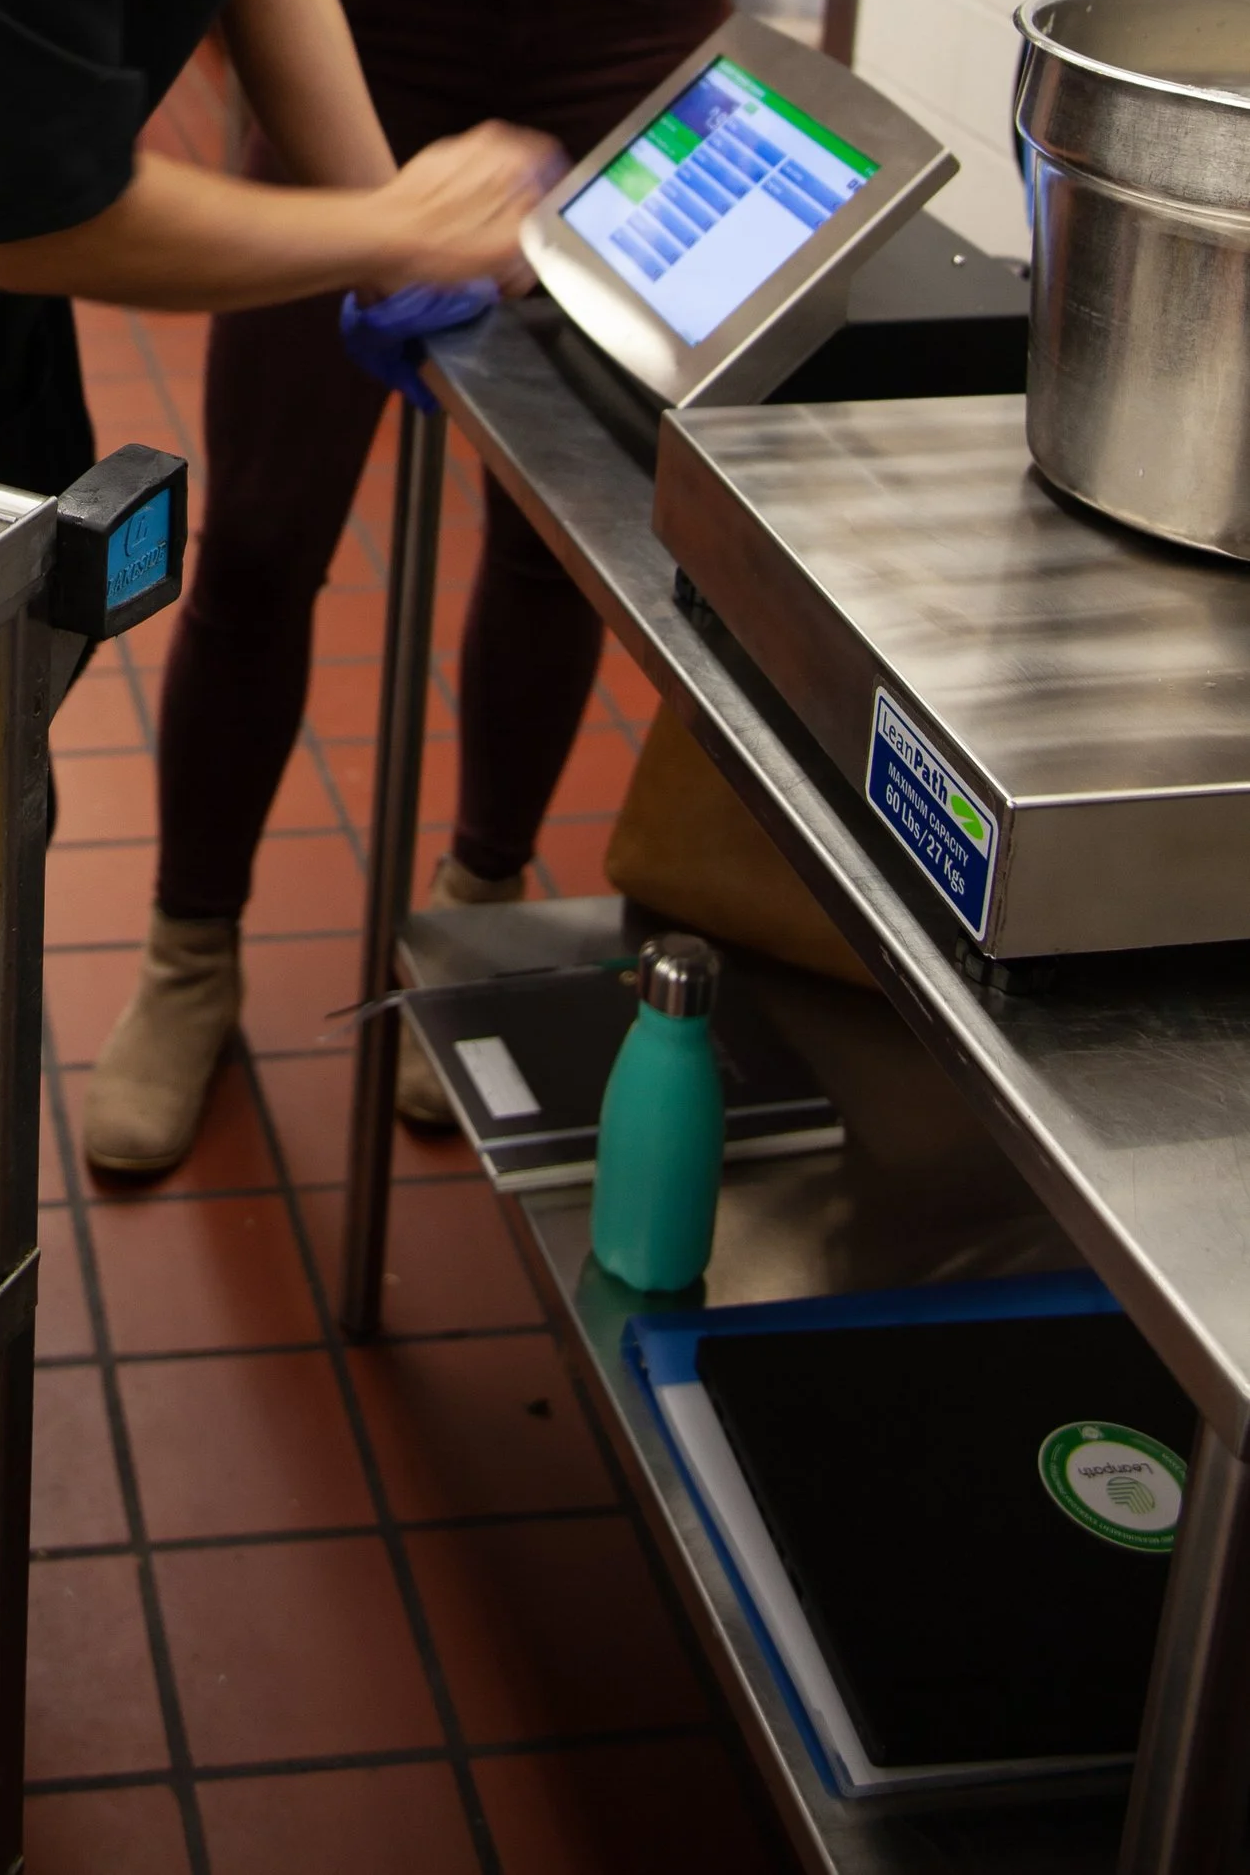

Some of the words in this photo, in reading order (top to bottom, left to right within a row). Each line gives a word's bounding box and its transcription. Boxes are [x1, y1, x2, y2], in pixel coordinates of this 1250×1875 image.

[882, 710, 948, 806] LeanPath
[885, 783, 900, 813] 60
[943, 854, 966, 895] Kgs
[888, 761, 928, 819] MAXIMUM
[930, 811, 969, 867] CAPACITY
[1077, 1462, 1154, 1478] Leanpath
